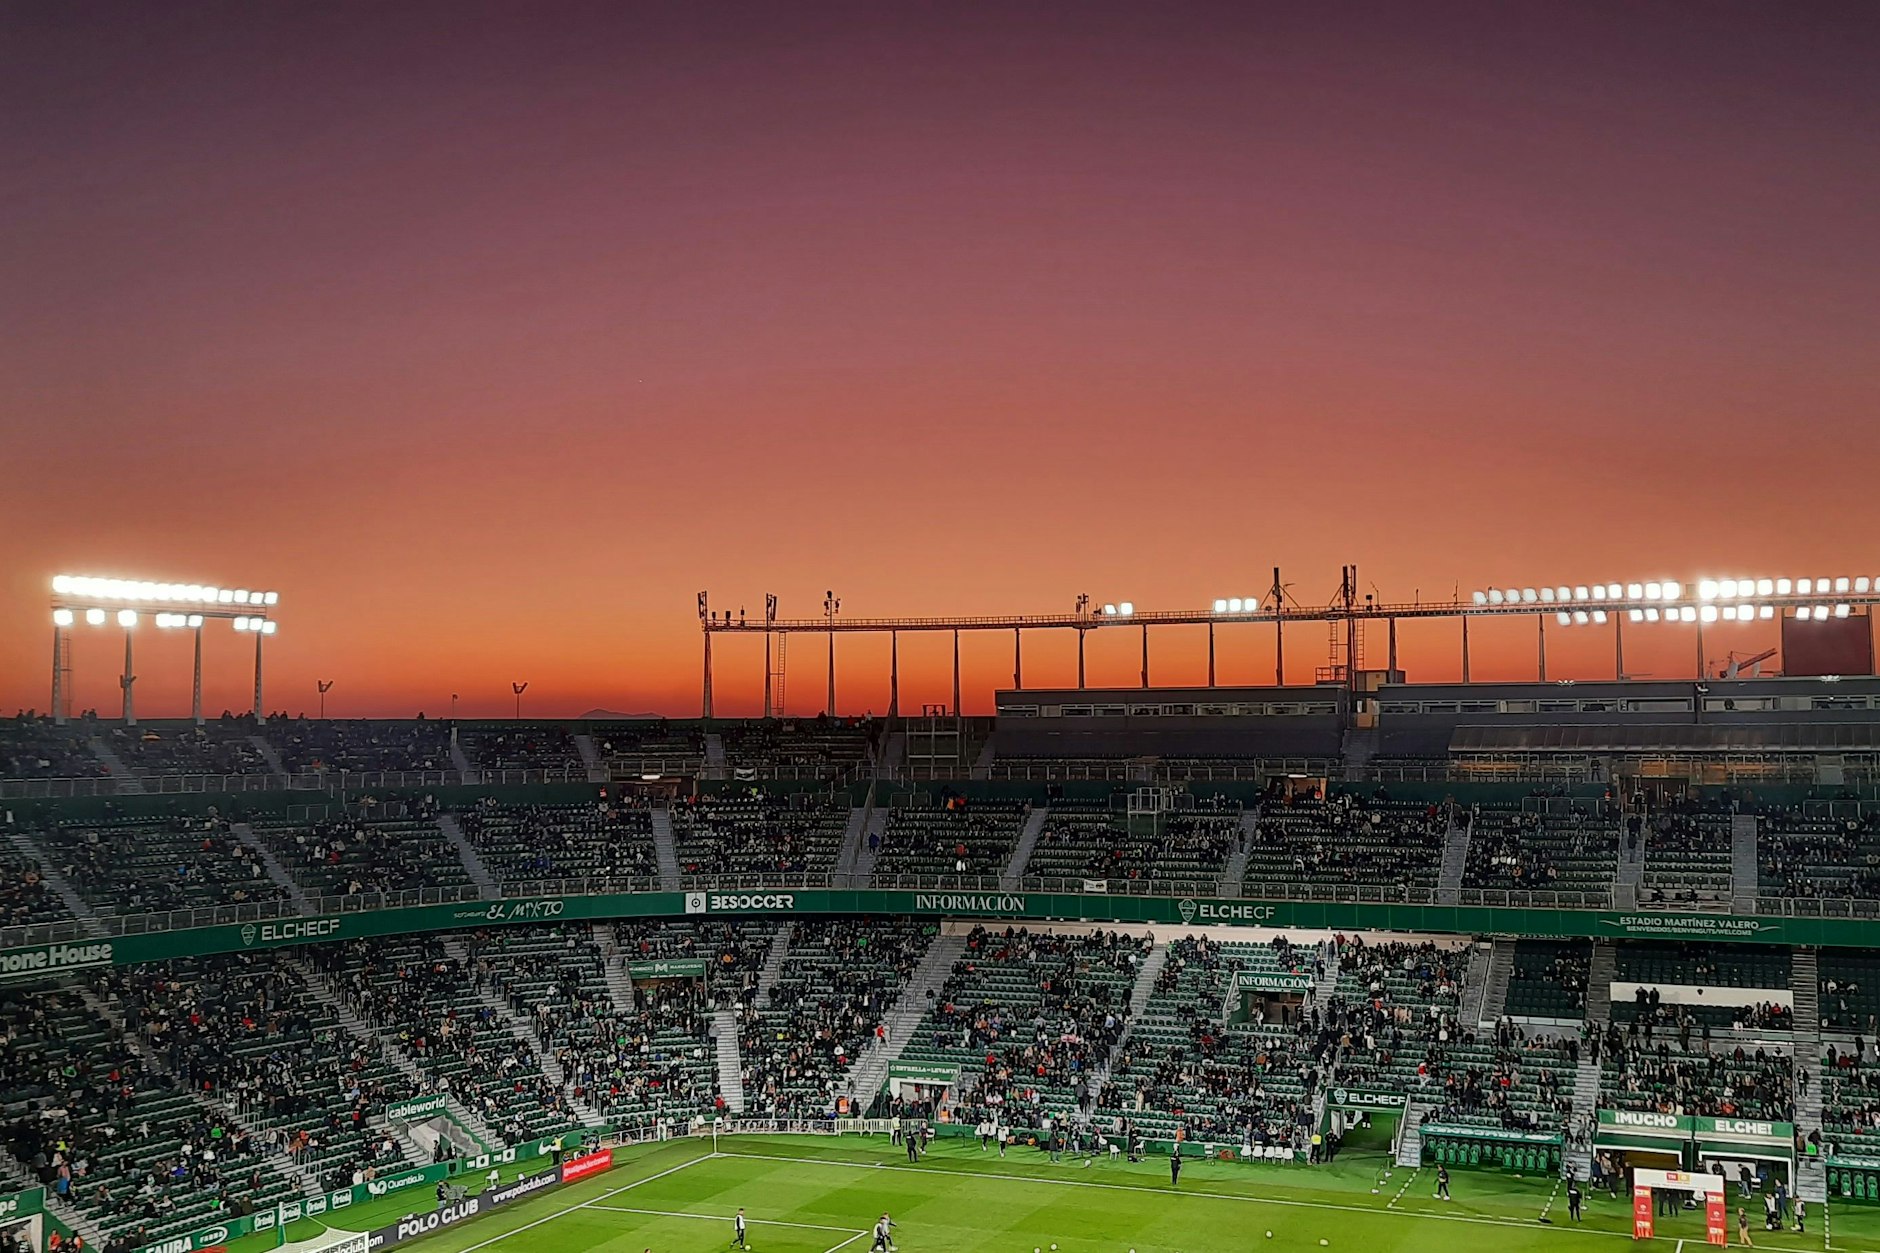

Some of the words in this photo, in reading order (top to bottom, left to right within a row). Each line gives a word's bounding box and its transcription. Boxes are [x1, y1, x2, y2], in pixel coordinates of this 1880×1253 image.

[711, 894, 794, 909] BESOCCER
[916, 892, 1025, 912] INFORMACIÓN
[1619, 916, 1662, 926] ESTADIO
[1664, 916, 1716, 928] MARTÍNEZ
[1719, 919, 1760, 930] VALERO
[48, 943, 113, 966] House
[1239, 975, 1309, 989] INFORMACIÓN
[388, 1096, 446, 1119] cableworld
[1714, 1119, 1773, 1136] ELCHE!
[492, 1174, 556, 1204] www.poloclub.com
[398, 1213, 439, 1240] POLO
[442, 1199, 479, 1224] CLUB
